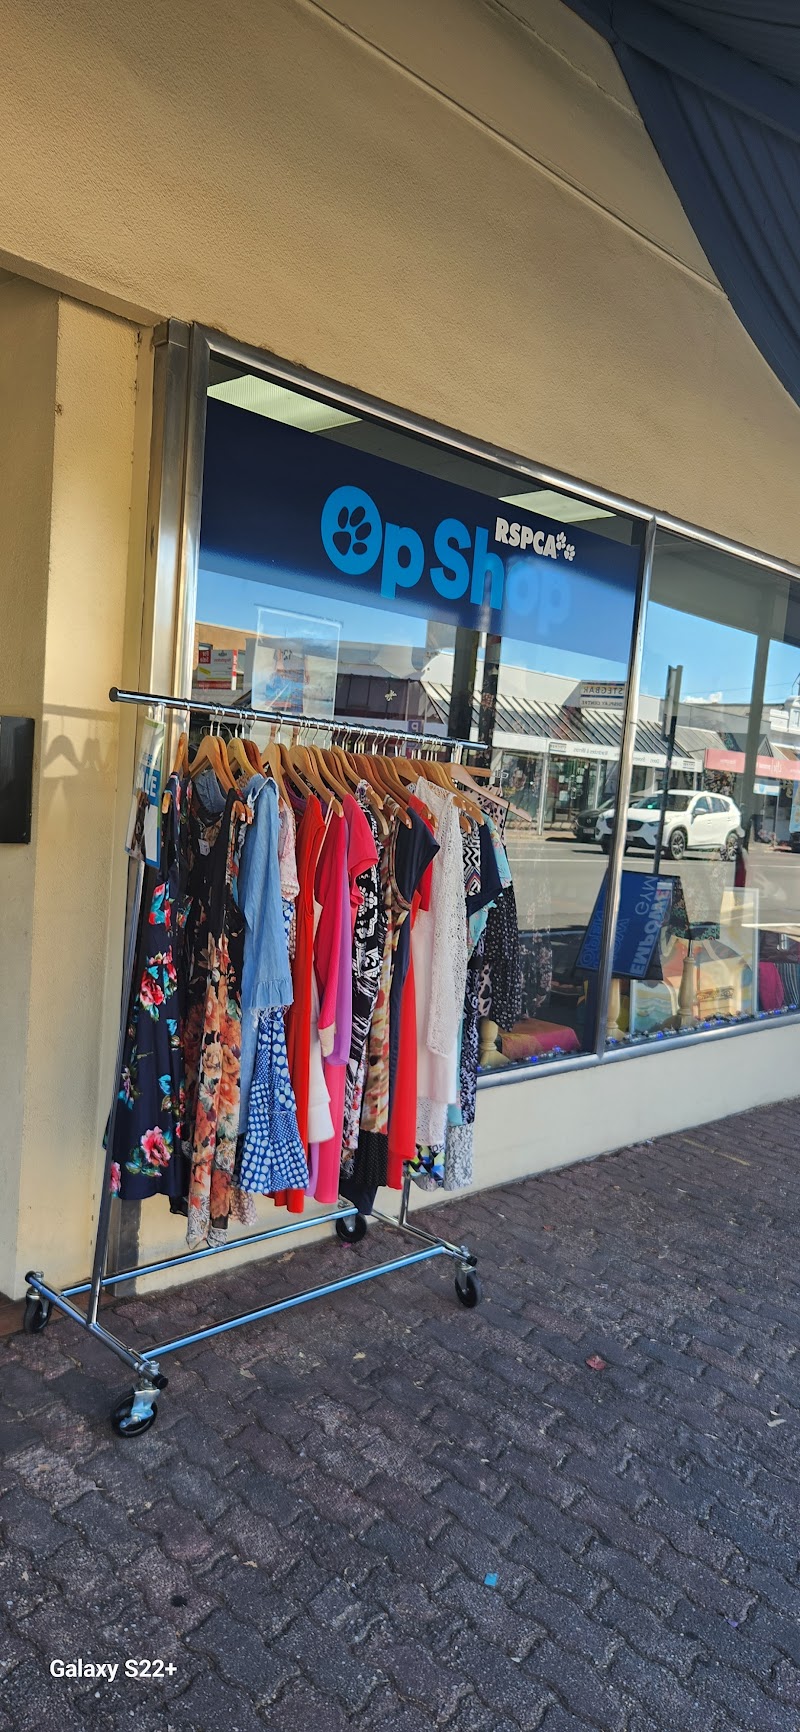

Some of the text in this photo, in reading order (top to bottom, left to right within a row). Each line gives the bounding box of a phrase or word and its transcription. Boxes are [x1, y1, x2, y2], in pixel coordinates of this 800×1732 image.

[320, 485, 572, 634] Op Shop
[494, 517, 558, 558] RSPCA
